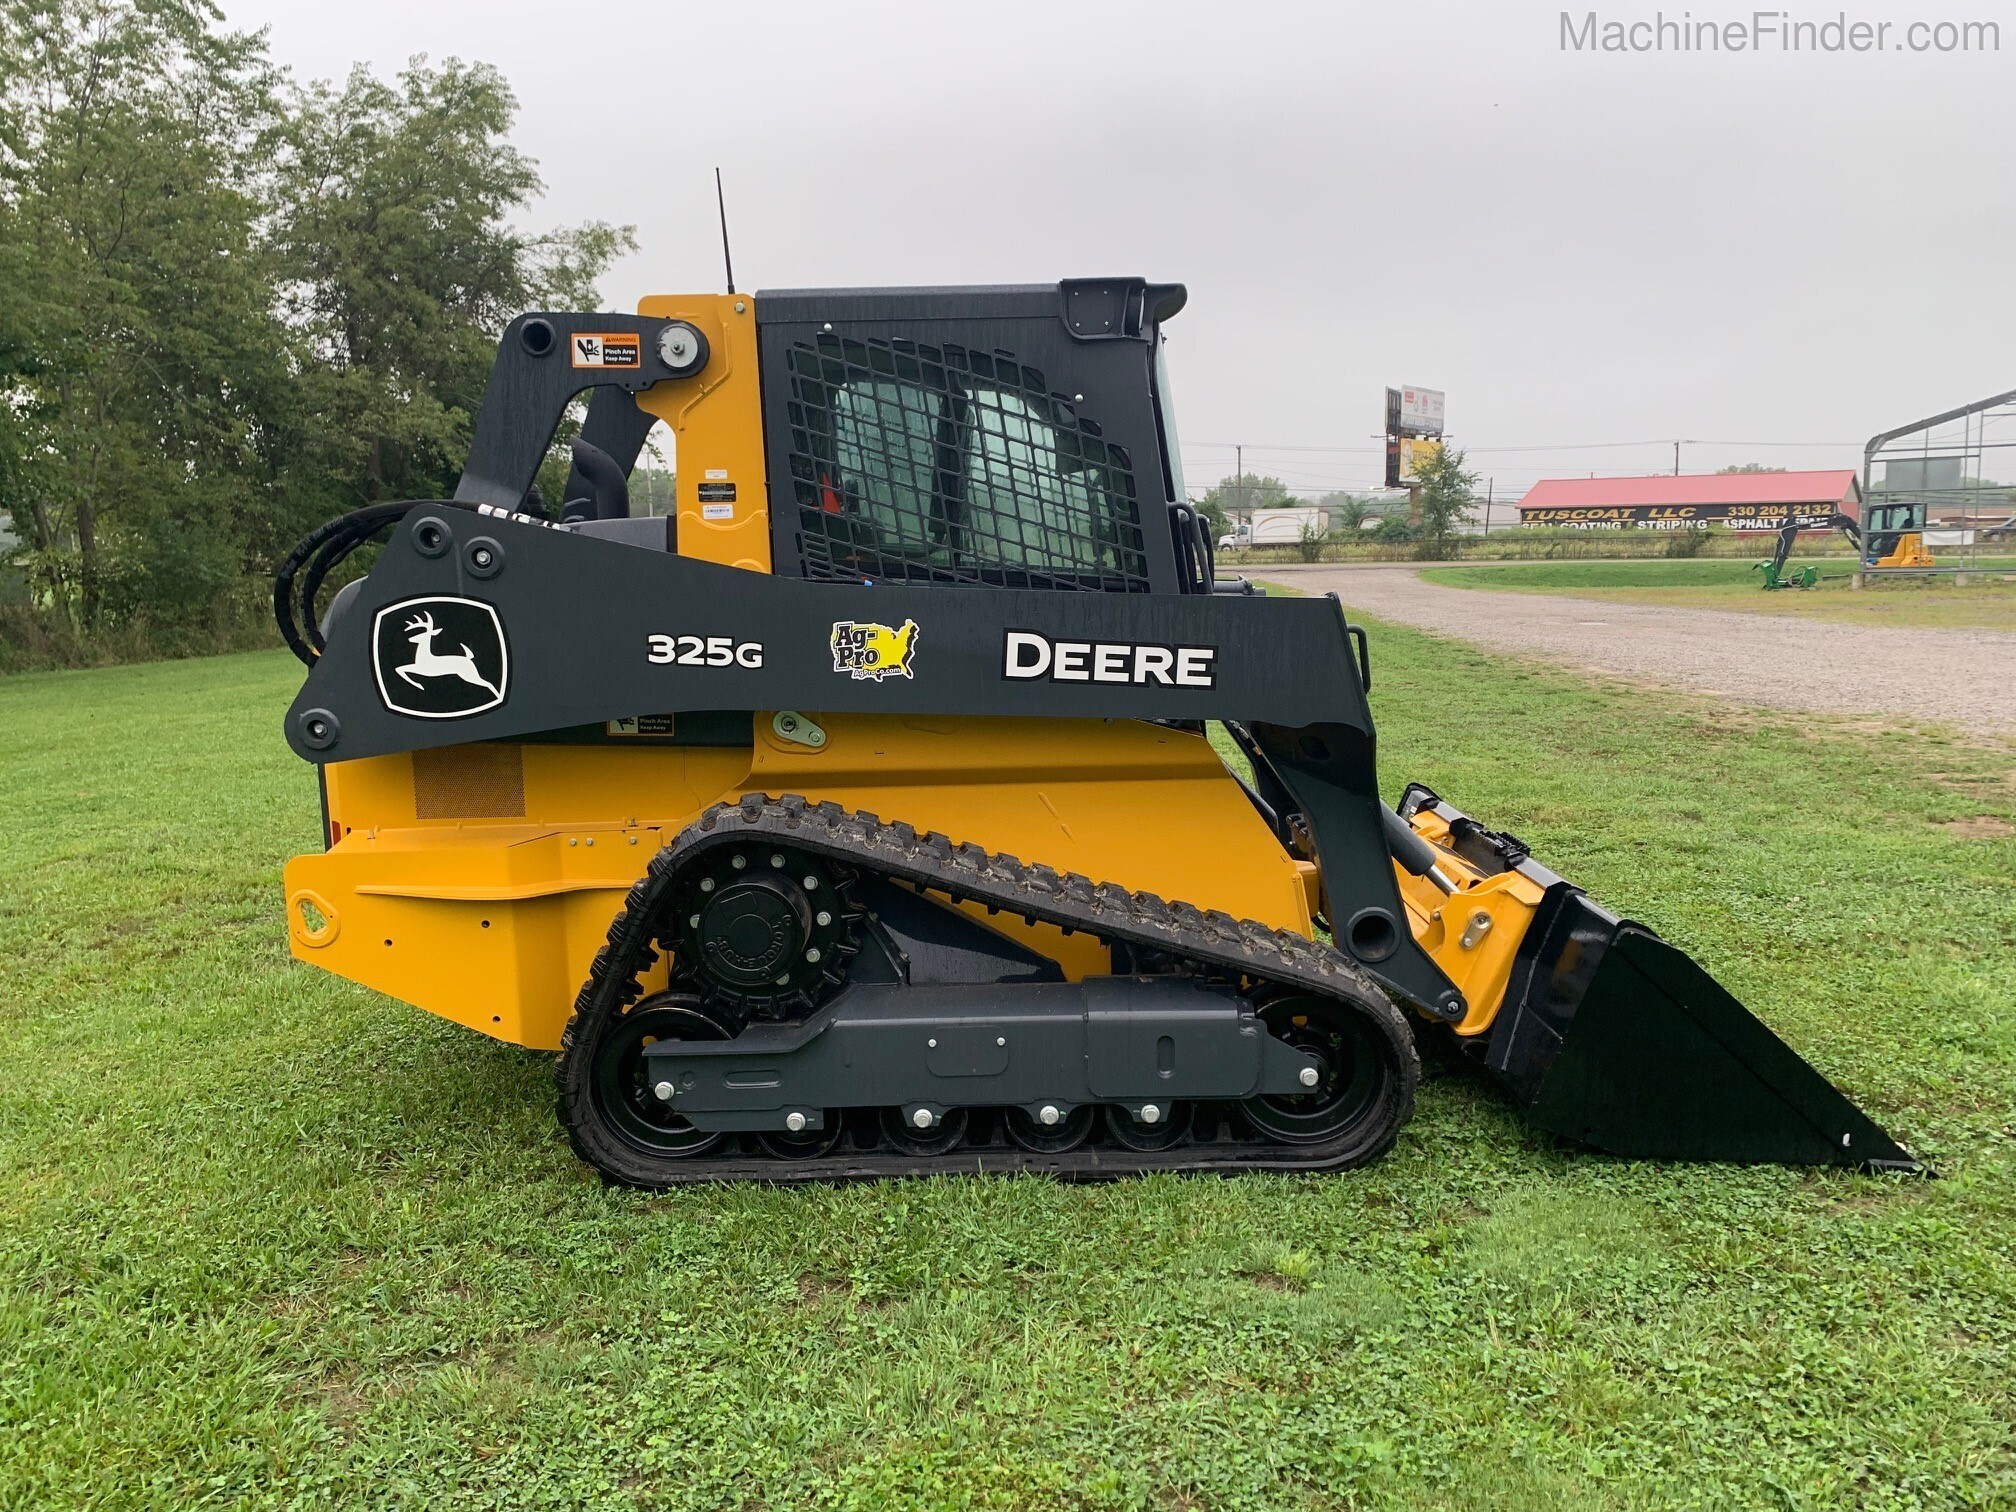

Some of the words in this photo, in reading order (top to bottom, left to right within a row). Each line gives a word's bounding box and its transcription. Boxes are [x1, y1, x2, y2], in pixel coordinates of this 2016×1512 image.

[1524, 509, 1636, 520] TUSCOAT
[1648, 506, 1697, 518] LLC
[1727, 506, 1756, 516] 330
[1759, 506, 1788, 516] 204
[1792, 504, 1832, 515] 2132
[1637, 520, 1707, 530] STRIPING
[1722, 518, 1780, 530] ASPHALT
[835, 625, 876, 649] Ag-
[648, 634, 763, 668] 325G
[838, 647, 879, 668] Pro
[1005, 632, 1214, 686] DEERE
[854, 667, 902, 678] AgProCo.com
